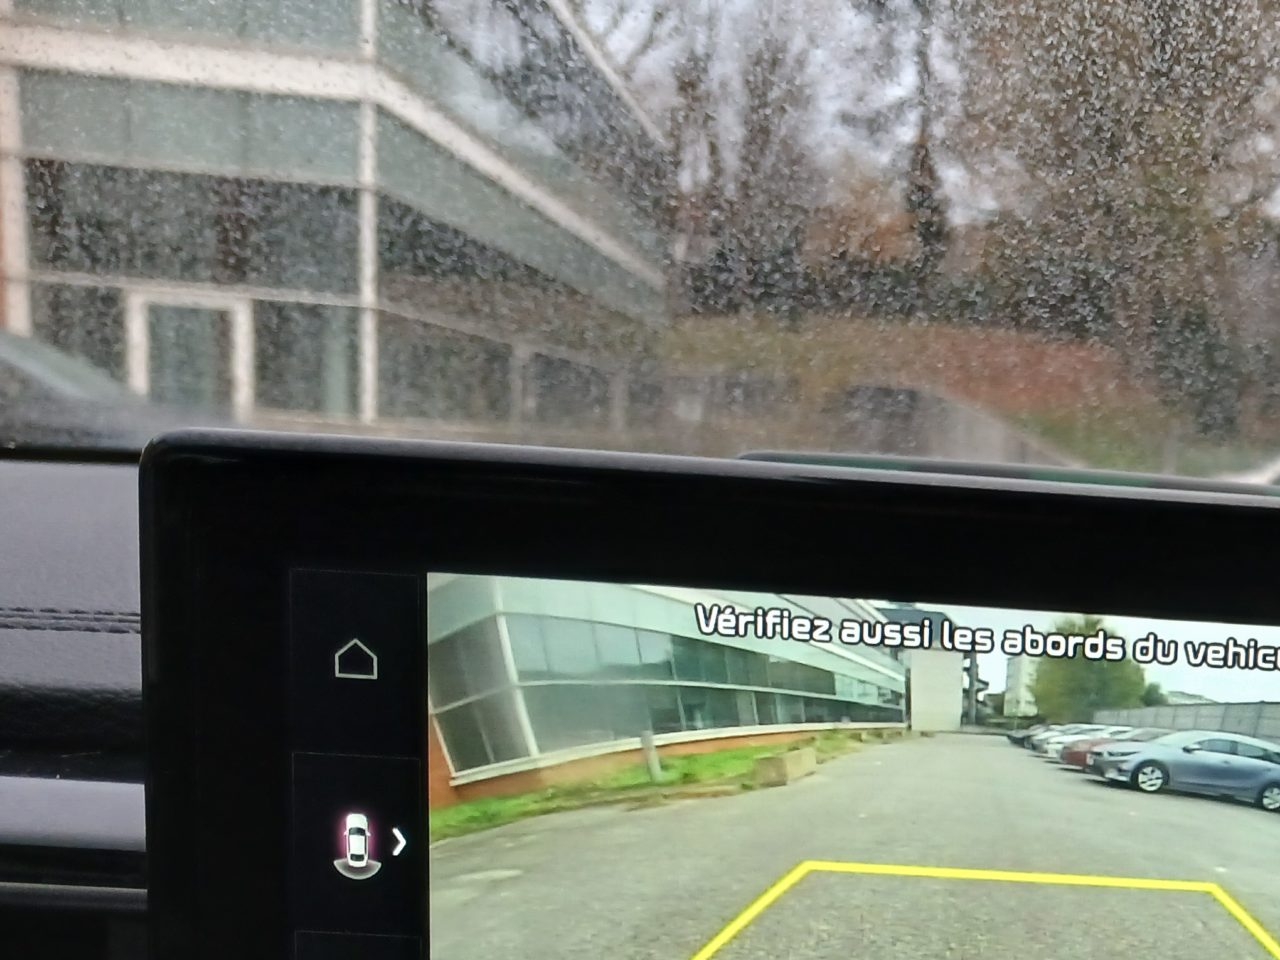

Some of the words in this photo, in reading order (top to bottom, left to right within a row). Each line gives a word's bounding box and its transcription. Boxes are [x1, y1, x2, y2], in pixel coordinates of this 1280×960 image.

[695, 603, 833, 643] Vérifiez
[839, 617, 933, 649] aussi
[941, 618, 994, 654] les
[1002, 624, 1126, 661] abords
[1133, 632, 1178, 665] du
